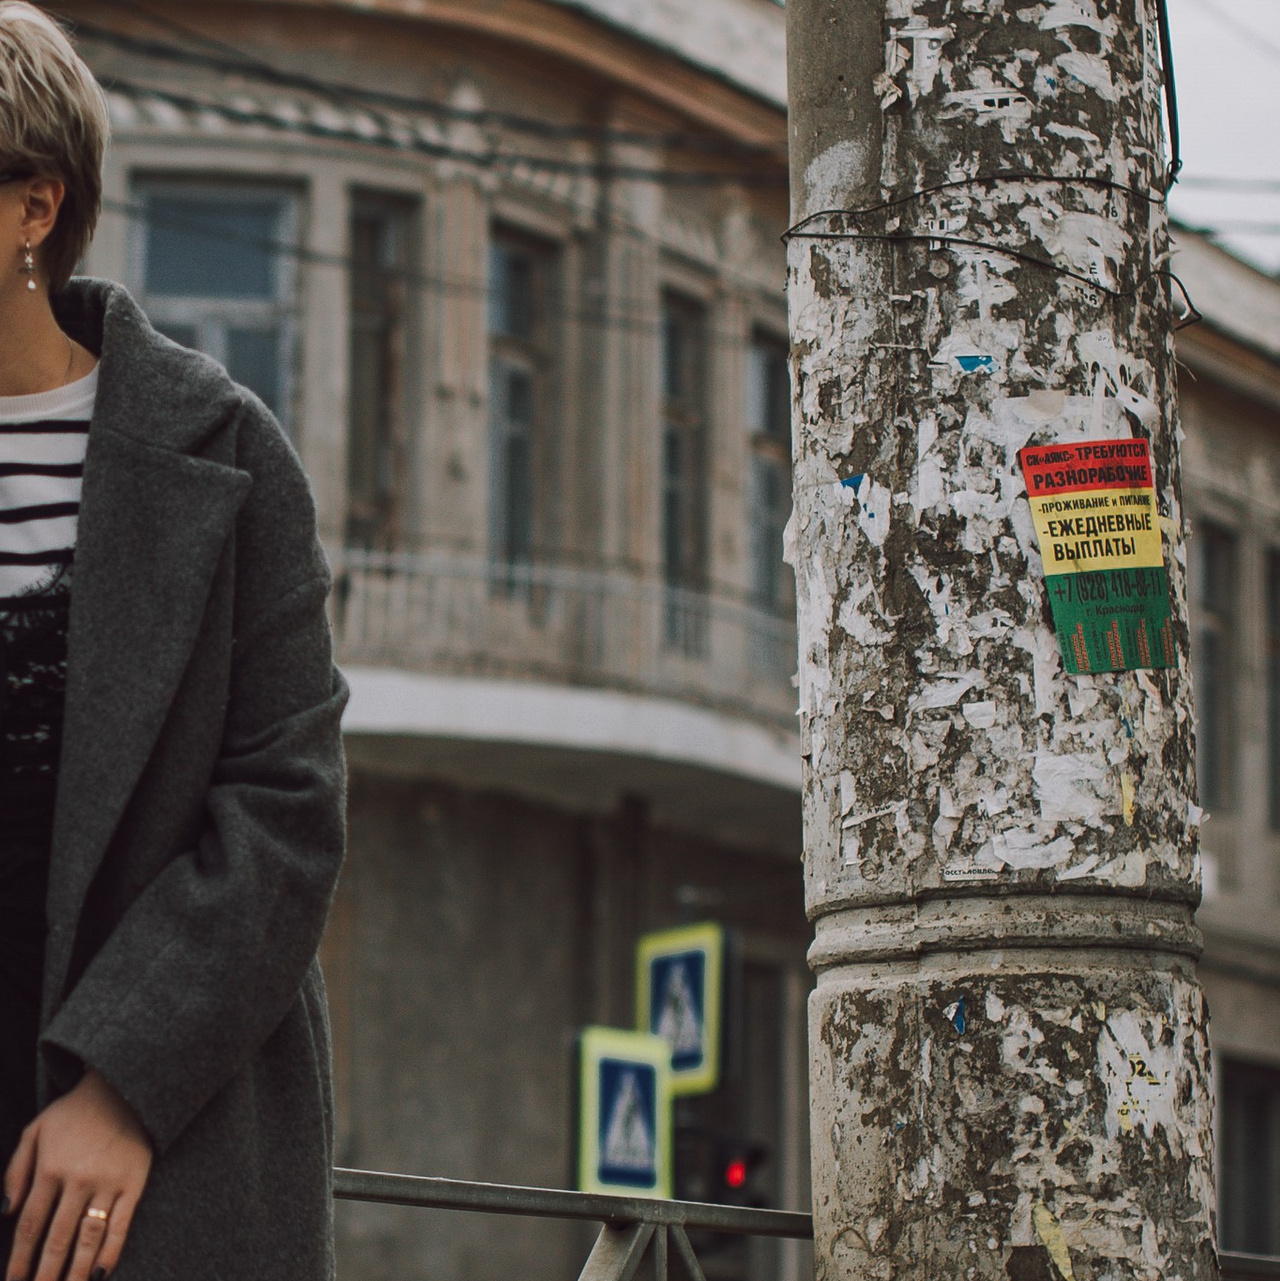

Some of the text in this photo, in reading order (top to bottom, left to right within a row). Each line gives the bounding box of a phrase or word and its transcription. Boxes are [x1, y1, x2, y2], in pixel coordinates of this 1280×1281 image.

[1075, 443, 1147, 461] ТРЕБУЮТСЯ
[1033, 465, 1148, 490] РАЗНОРАБОЧИЕ
[1119, 494, 1151, 506] ПИТАНИЕ
[1053, 537, 1136, 562] ВЫПЛАТЫ
[1054, 576, 1072, 603] +7
[1075, 571, 1109, 605] (928)
[1095, 604, 1145, 617] Краснодар
